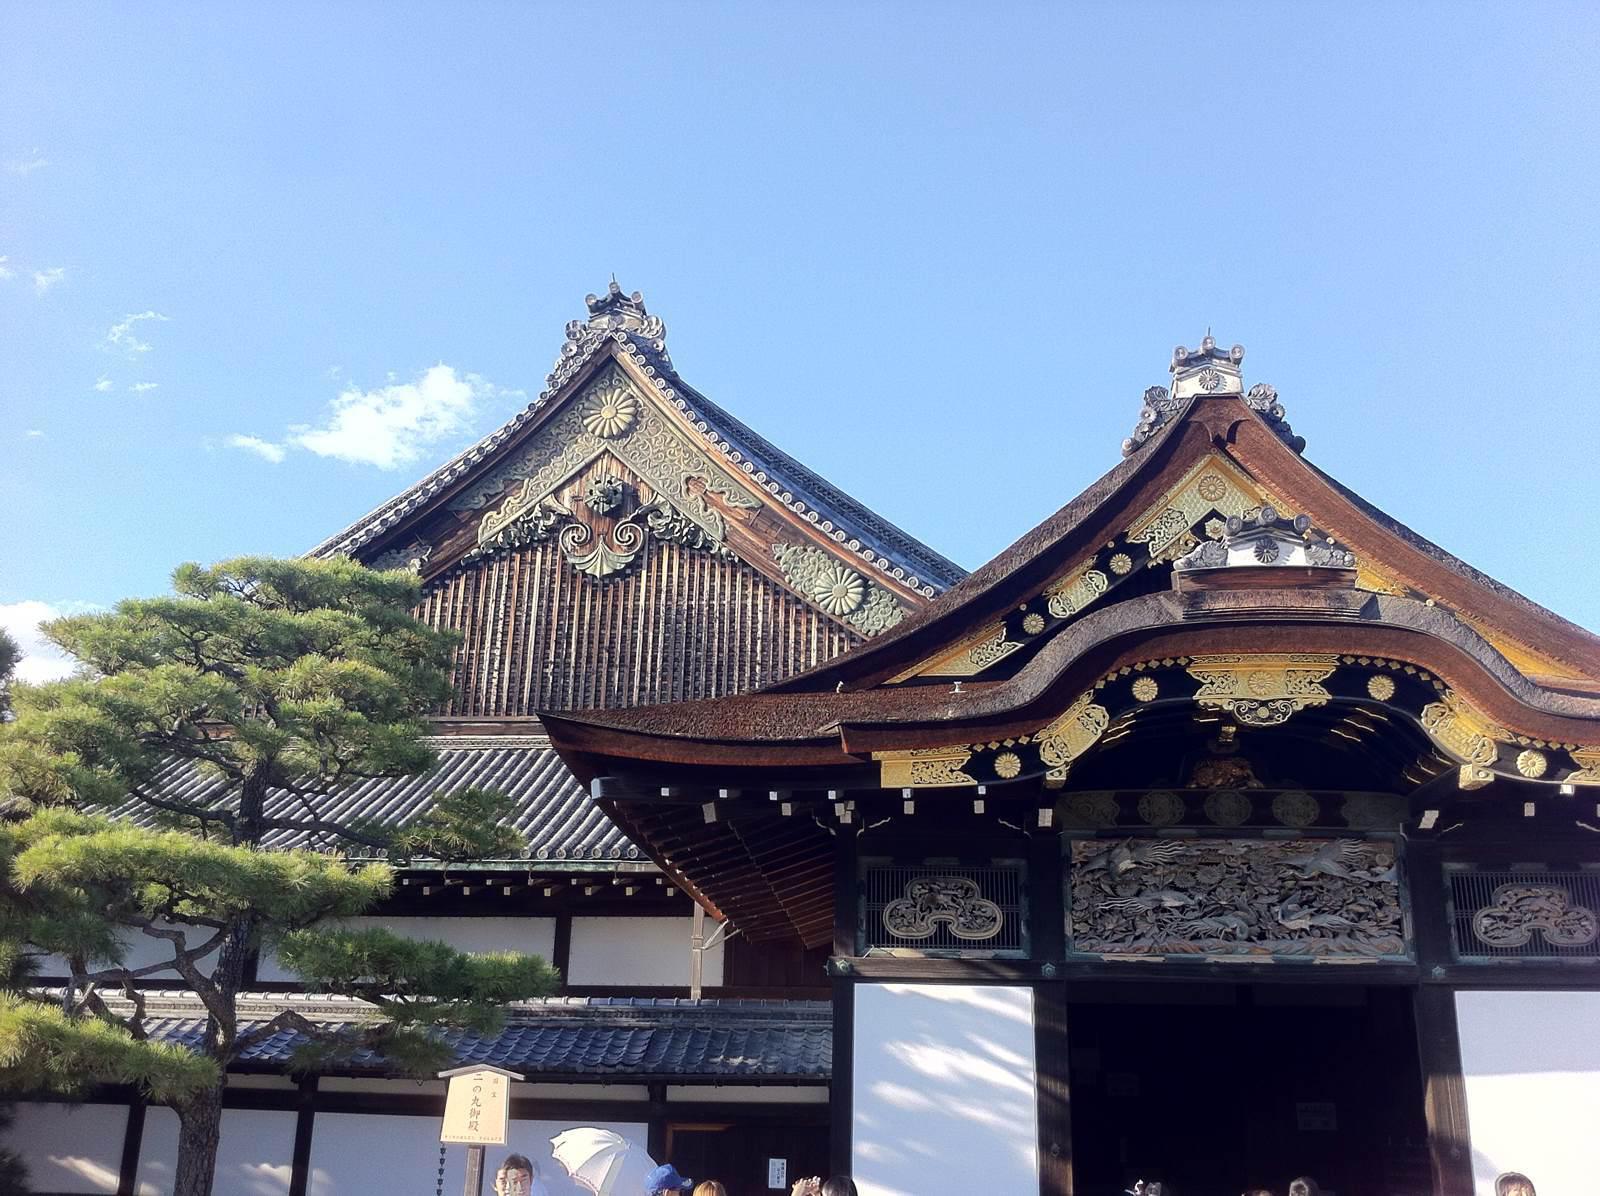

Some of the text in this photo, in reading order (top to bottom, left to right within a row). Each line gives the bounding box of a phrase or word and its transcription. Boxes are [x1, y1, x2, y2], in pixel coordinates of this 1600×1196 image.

[468, 1073, 483, 1132] 二の丸御殿
